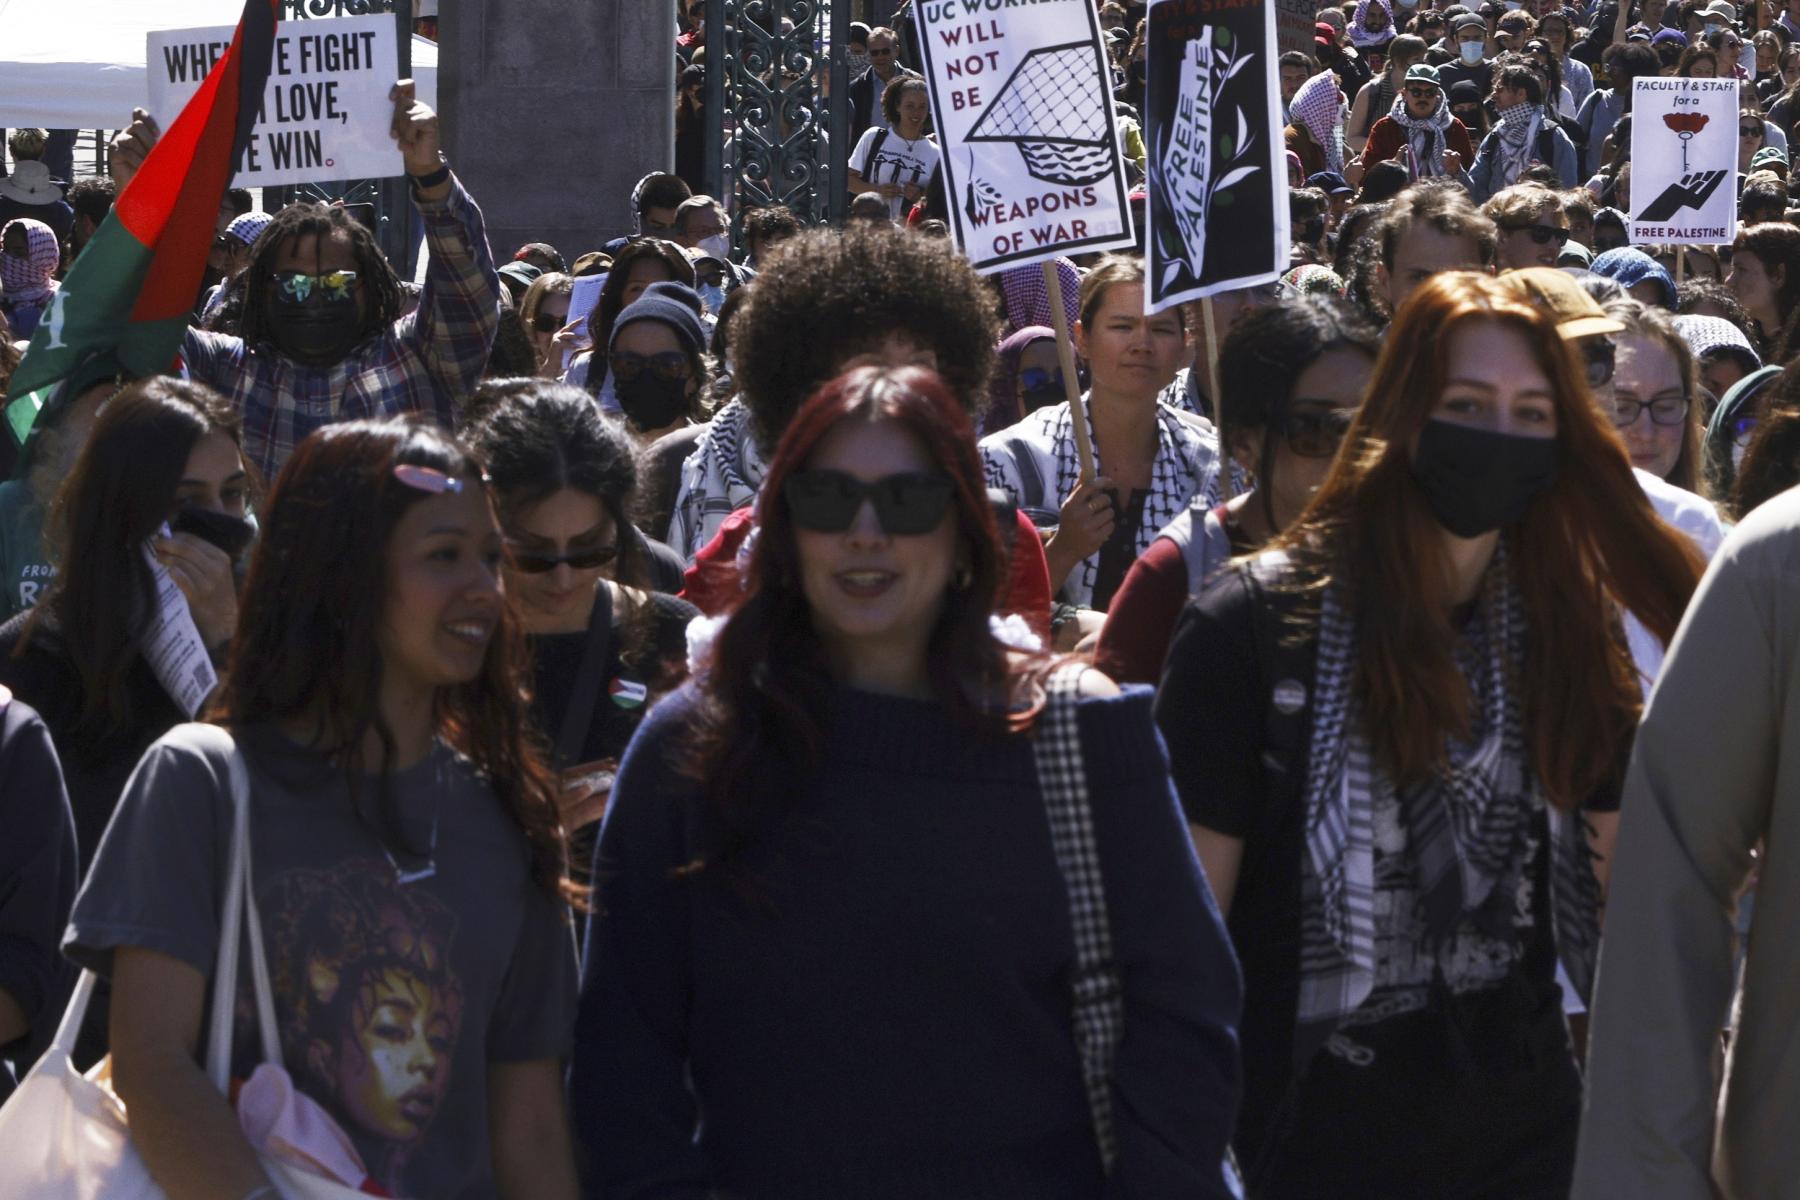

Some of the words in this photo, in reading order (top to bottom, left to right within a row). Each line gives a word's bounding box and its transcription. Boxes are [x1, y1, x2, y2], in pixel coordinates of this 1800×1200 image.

[926, 1, 956, 24] UC
[939, 20, 1005, 48] WILL
[163, 41, 231, 84] WHE
[300, 31, 376, 74] FIGHT
[945, 51, 1000, 80] NOT
[951, 87, 982, 111] BE
[1636, 81, 1689, 91] FACULTY
[1691, 81, 1699, 91] &
[1702, 82, 1734, 91] STAFF
[275, 81, 347, 125] LOVE,
[1673, 96, 1690, 107] for
[1164, 94, 1193, 200] FREE
[1175, 43, 1209, 257] PALESTINE
[972, 187, 1098, 229] WEAPONS
[993, 225, 1024, 256] OF
[1030, 219, 1088, 249] WAR
[1635, 227, 1665, 237] FREE
[1667, 227, 1726, 238] PALESTINE
